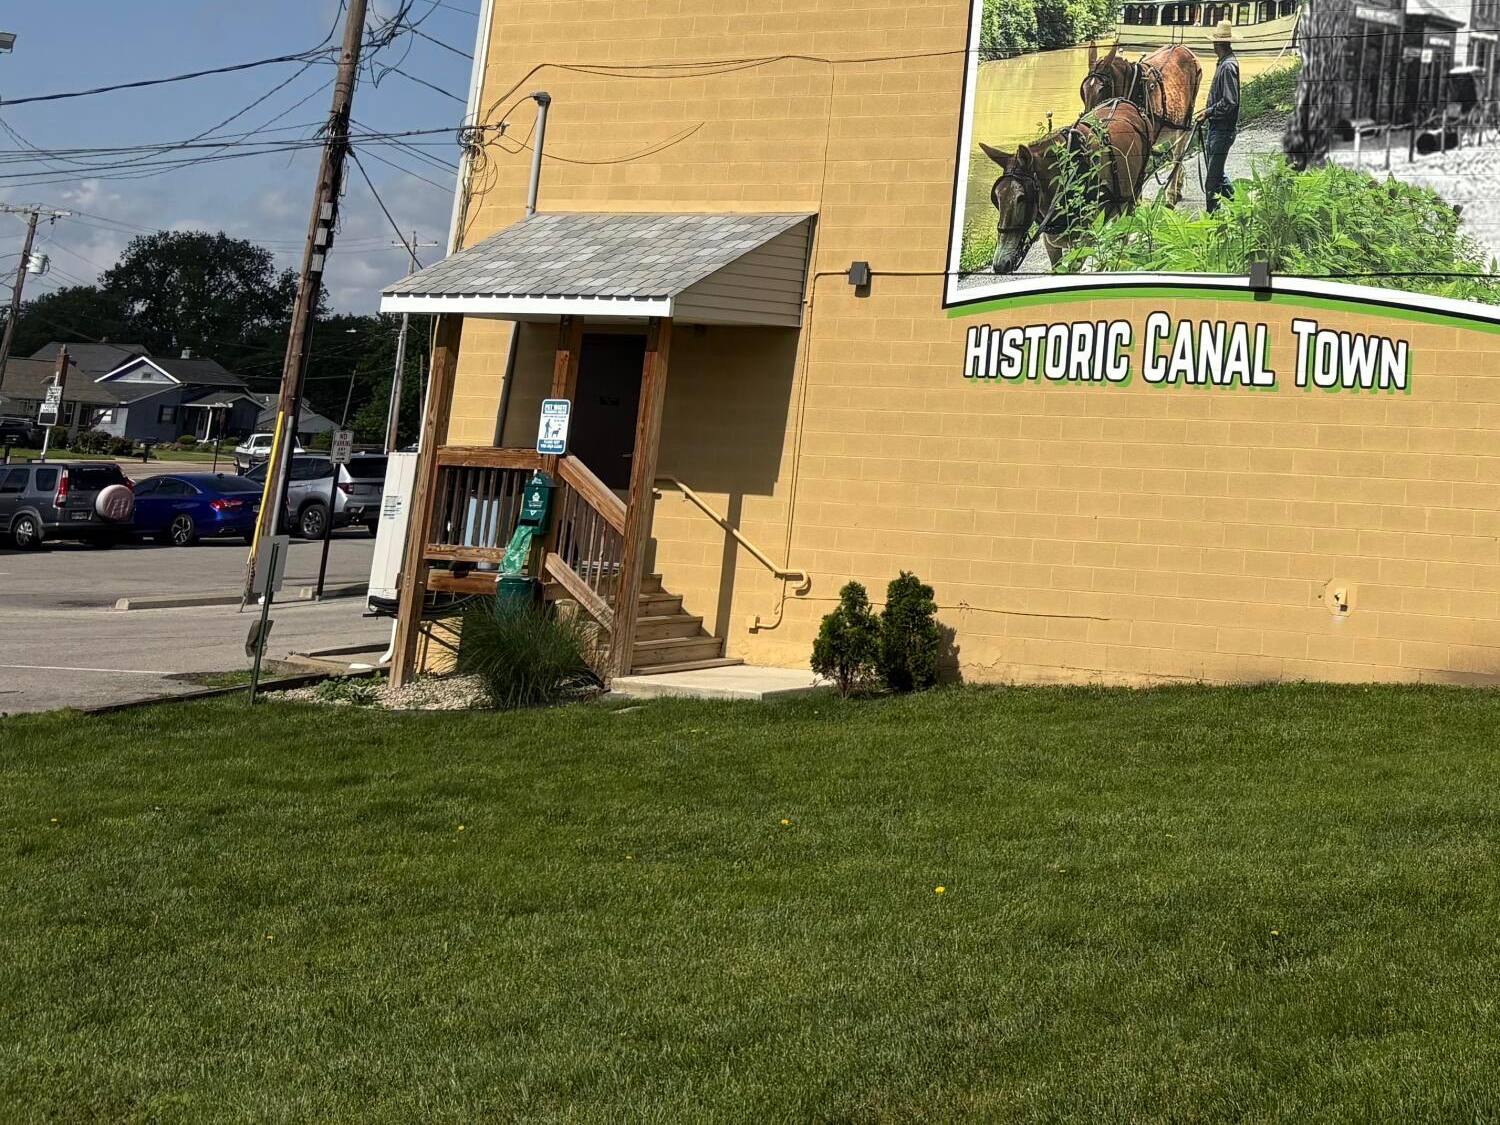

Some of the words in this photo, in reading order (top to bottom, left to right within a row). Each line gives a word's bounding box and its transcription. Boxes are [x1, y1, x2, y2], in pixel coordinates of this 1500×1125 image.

[963, 320, 1131, 383] HISTORIC
[1141, 311, 1276, 387] CANAL
[1291, 318, 1410, 390] TOWN
